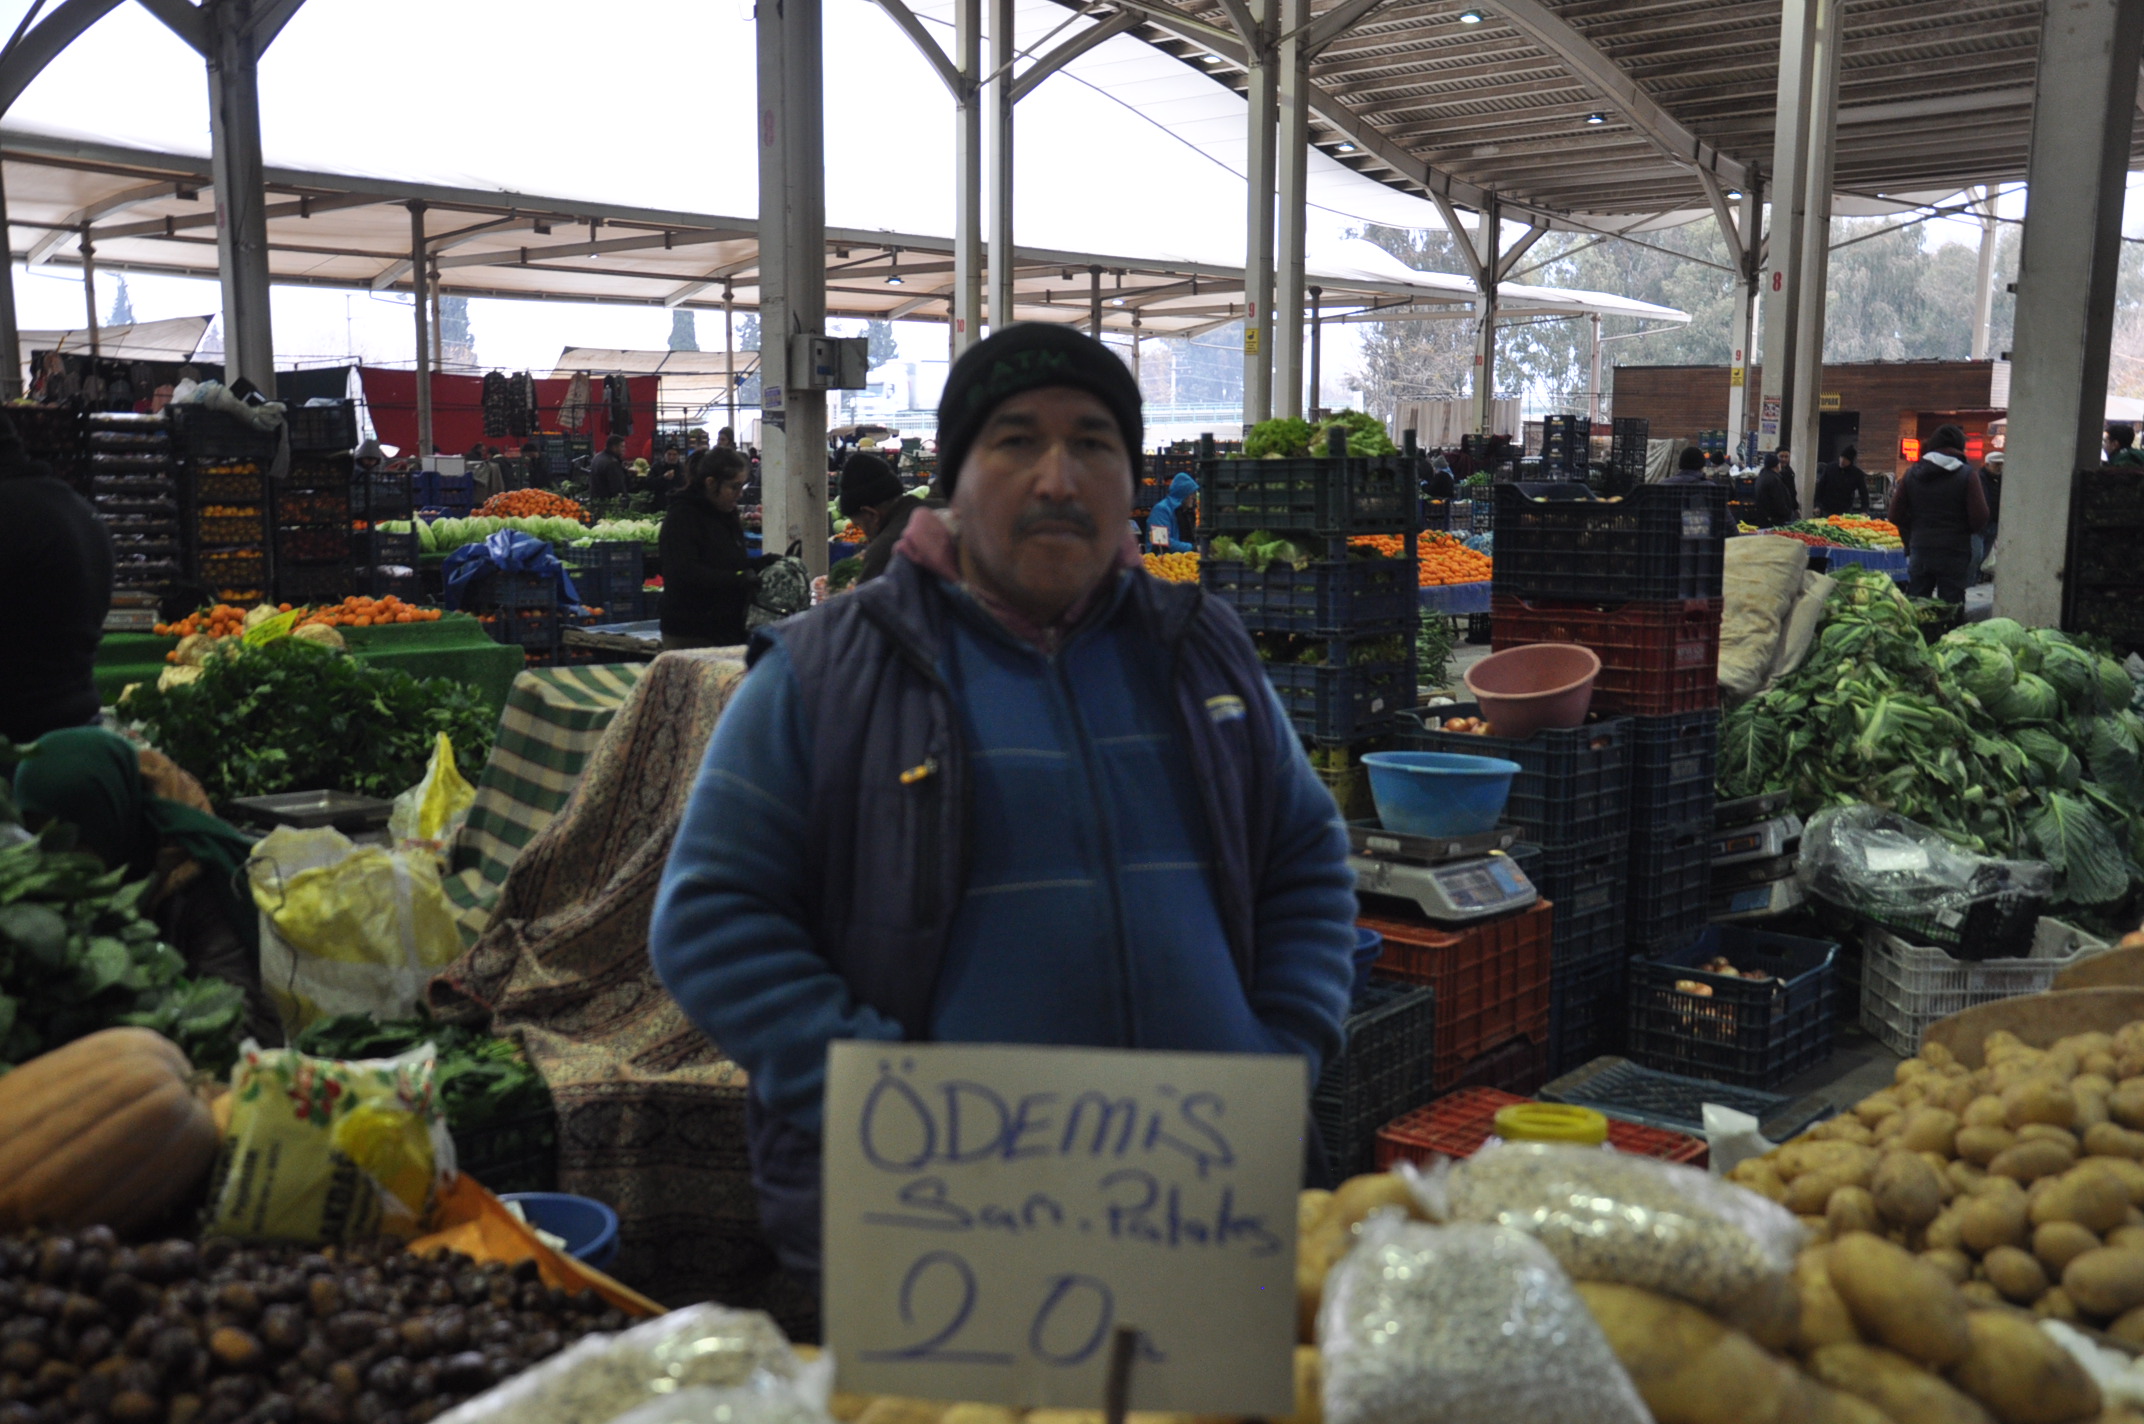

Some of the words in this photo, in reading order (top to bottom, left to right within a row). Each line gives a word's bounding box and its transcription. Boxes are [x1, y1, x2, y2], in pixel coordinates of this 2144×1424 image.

[1772, 271, 1782, 292] 8
[1248, 301, 1256, 318] 9
[956, 318, 965, 333] 10
[1735, 349, 1742, 361] 9
